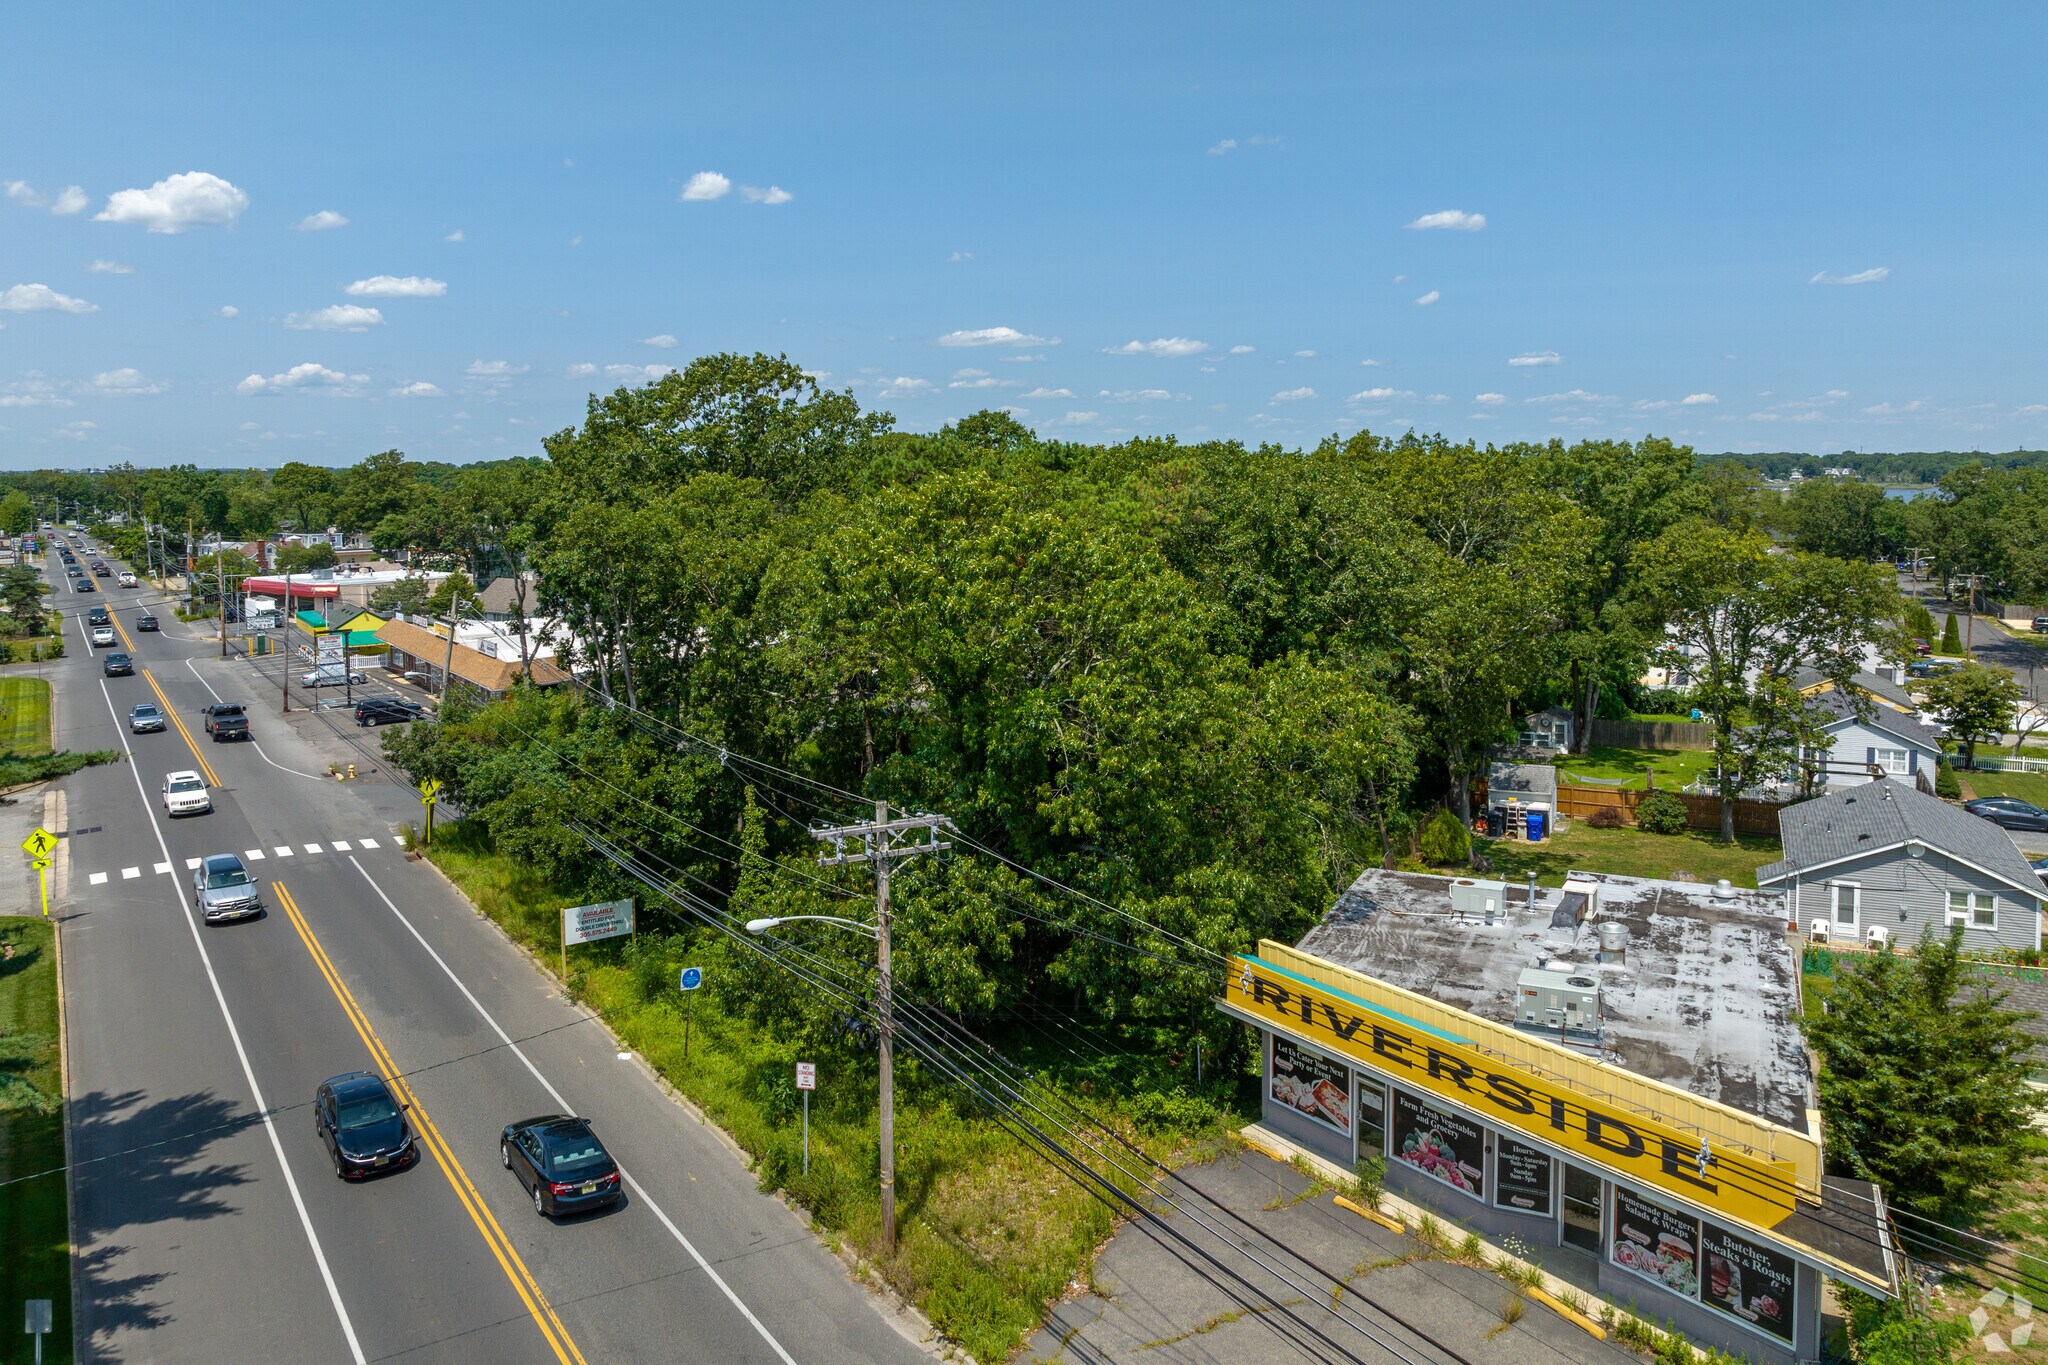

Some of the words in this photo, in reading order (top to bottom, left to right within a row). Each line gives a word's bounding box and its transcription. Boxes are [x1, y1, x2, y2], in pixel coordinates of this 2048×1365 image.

[582, 908, 614, 918] AVAILABLE
[582, 916, 604, 924] ENTITLED
[576, 924, 594, 932] DOUBLE
[1278, 1042, 1288, 1054] Let
[1288, 1048, 1296, 1056] Us
[1297, 1051, 1314, 1065] Cater
[1314, 1060, 1328, 1070] Your
[1330, 1066, 1344, 1078] Next
[1289, 1056, 1305, 1071] Party
[1314, 1067, 1332, 1081] Event
[1254, 976, 1719, 1197] RIVERSIDE
[1399, 1096, 1419, 1112] Farm
[1419, 1105, 1439, 1120] Fresh
[1440, 1115, 1477, 1139] Vegetables
[1416, 1114, 1428, 1124] and
[1430, 1119, 1460, 1140] Grocery
[1500, 1152, 1520, 1160] Monday
[1524, 1156, 1548, 1168] Saturday
[1512, 1146, 1534, 1156] Hours:
[1514, 1168, 1532, 1178] Sunday
[1617, 1191, 1662, 1218] Homemade
[1662, 1212, 1698, 1236] Burgers,
[1624, 1203, 1651, 1222] Salads
[1652, 1216, 1660, 1226] &
[1661, 1220, 1689, 1239] Wraps
[1702, 1237, 1741, 1263] Steaks
[1742, 1258, 1750, 1268] &
[1751, 1258, 1793, 1286] Roasts
[1722, 1235, 1771, 1268] Butcher,
